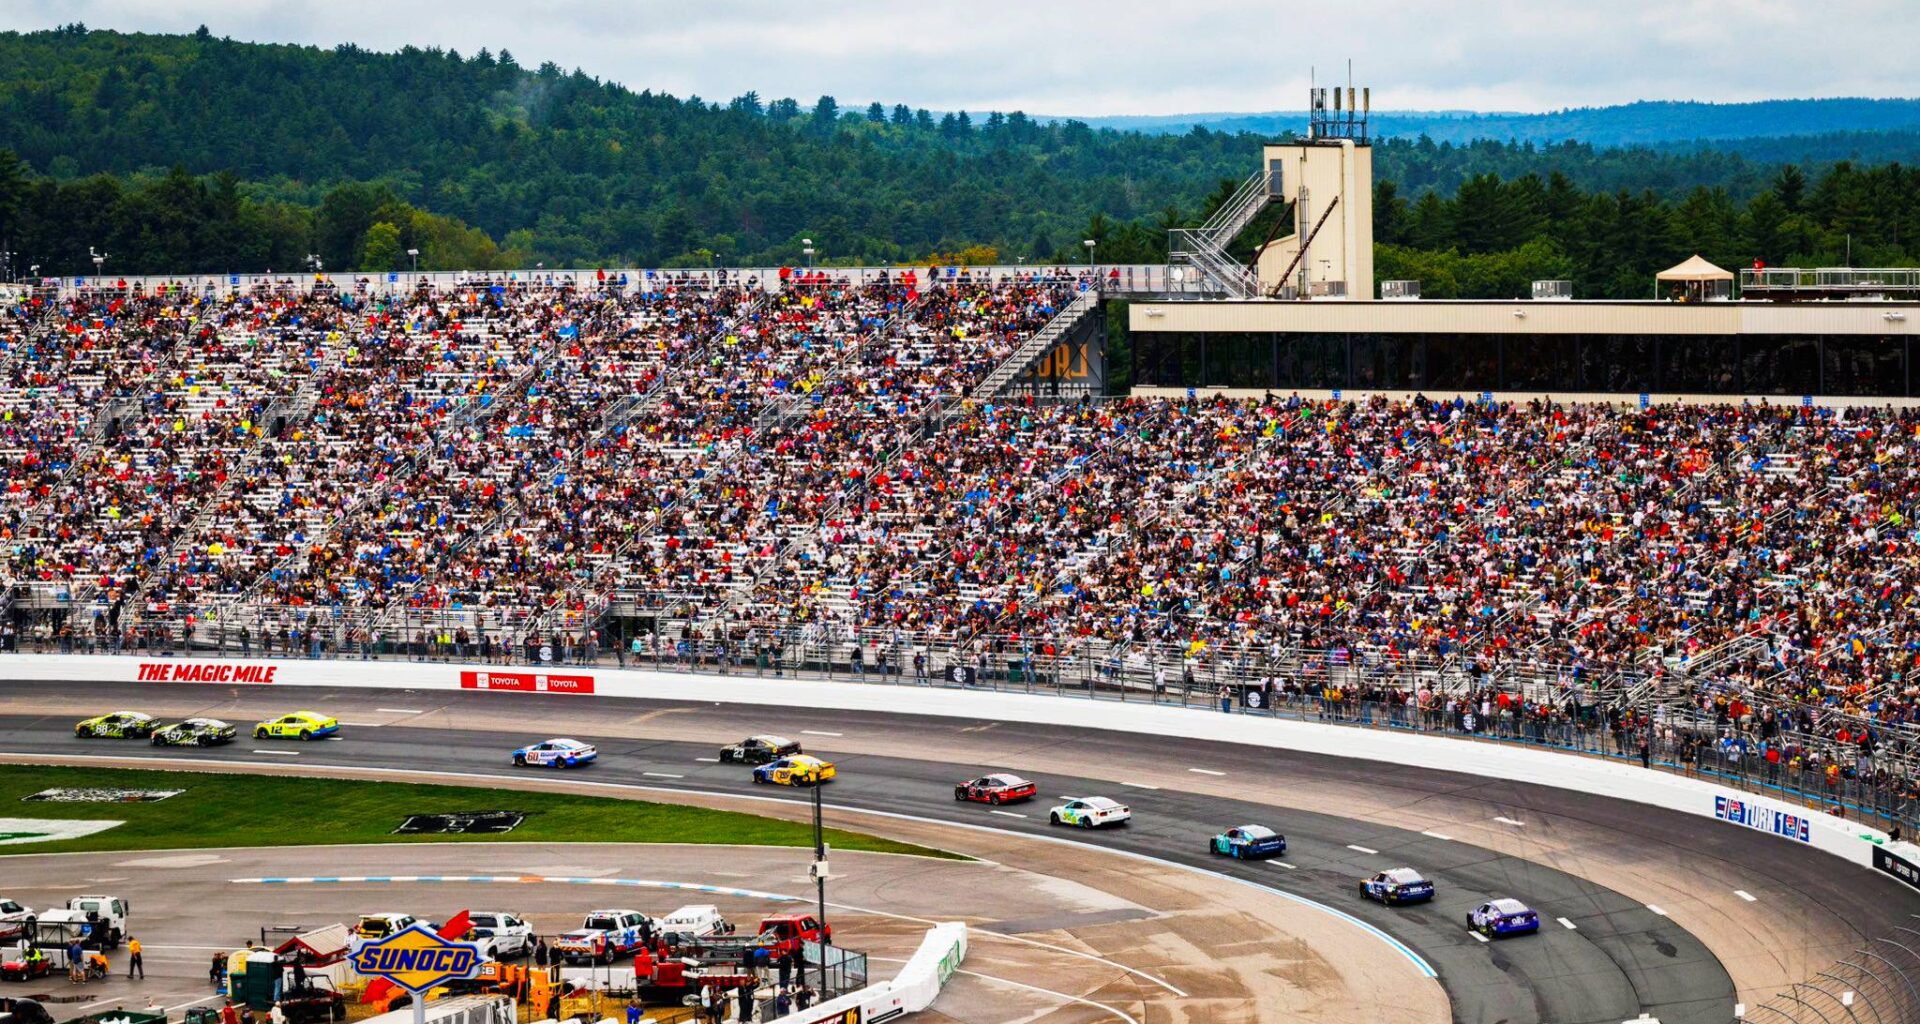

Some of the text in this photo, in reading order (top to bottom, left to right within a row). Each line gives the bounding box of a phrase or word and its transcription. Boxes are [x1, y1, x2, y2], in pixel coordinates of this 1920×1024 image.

[138, 664, 277, 683] THE MAGIC MILE
[491, 677, 519, 686] TOYOTA
[550, 680, 578, 688] TOYOTA
[96, 724, 107, 735] 88
[271, 726, 283, 734] 12
[527, 751, 539, 762] 60
[733, 747, 745, 758] 23
[1744, 803, 1775, 832] TURN
[1778, 813, 1784, 835] 1
[361, 948, 471, 971] SUNOCO
